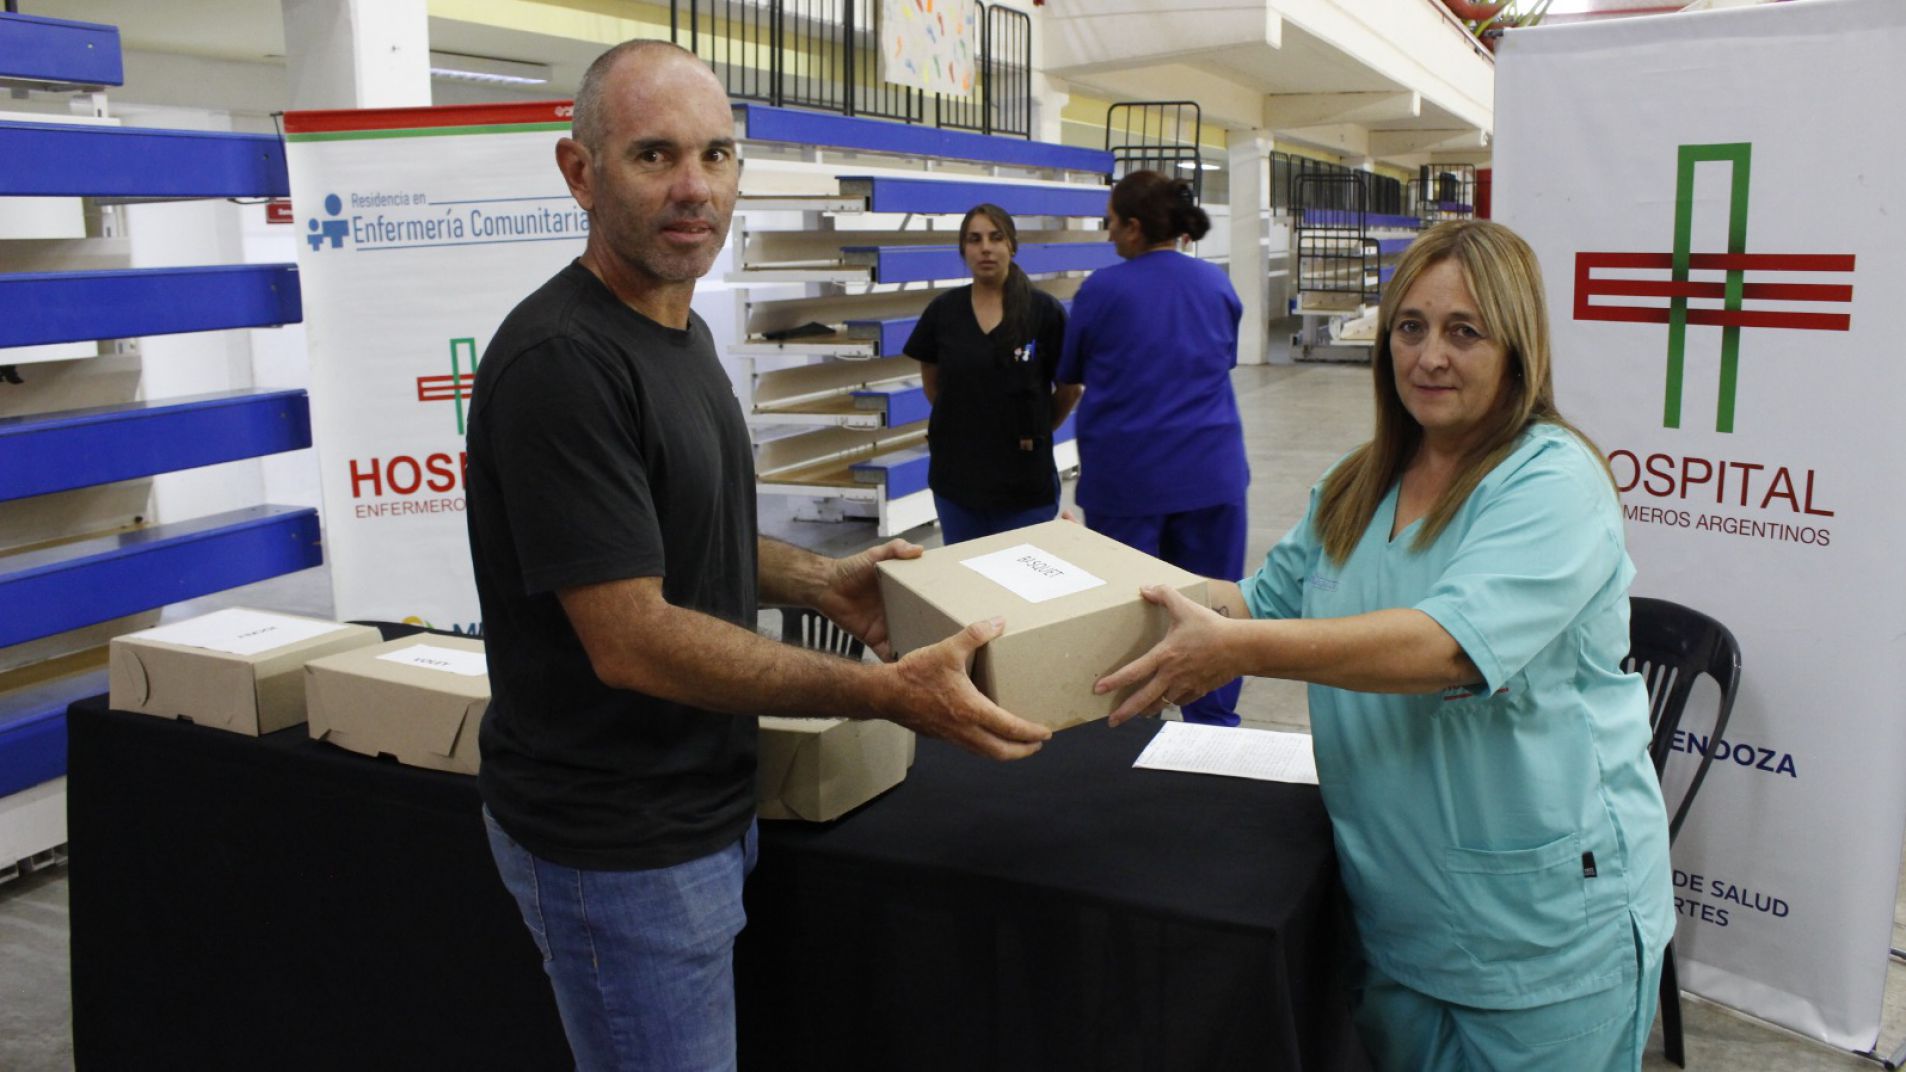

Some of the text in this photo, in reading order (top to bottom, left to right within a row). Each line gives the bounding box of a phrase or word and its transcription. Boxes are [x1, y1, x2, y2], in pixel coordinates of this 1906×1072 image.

[351, 192, 426, 208] Residencia en
[352, 205, 589, 244] Enfermería Comunitaria
[1607, 449, 1834, 517] OSPITAL
[355, 497, 467, 518] ENFERMERO
[1623, 504, 1831, 546] MEROS ARGENTINOS
[1670, 729, 1797, 778] ENDOZA
[1672, 869, 1789, 918] DE SALUD
[1674, 896, 1729, 927] RTES
